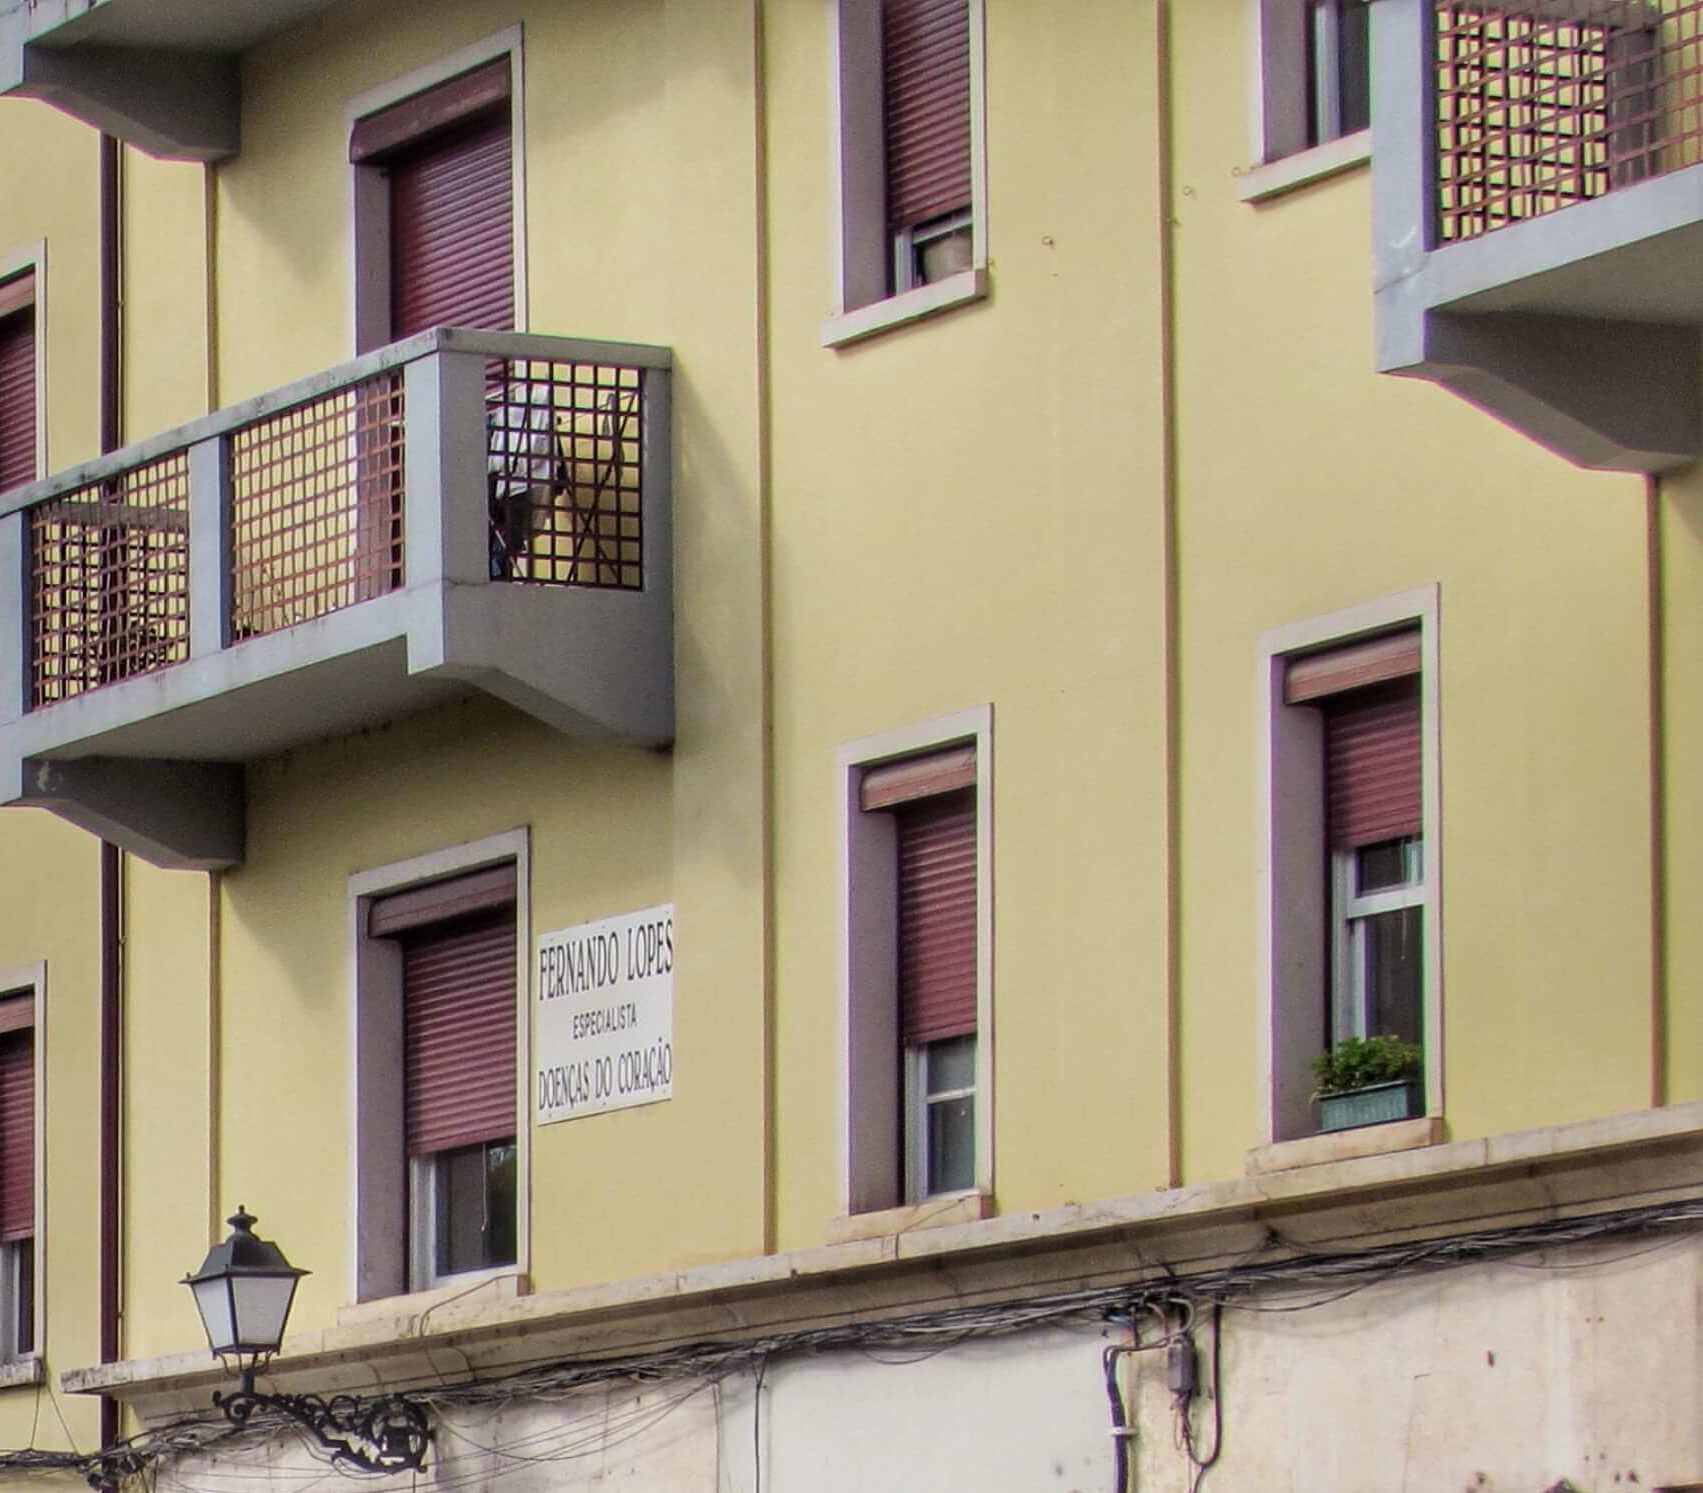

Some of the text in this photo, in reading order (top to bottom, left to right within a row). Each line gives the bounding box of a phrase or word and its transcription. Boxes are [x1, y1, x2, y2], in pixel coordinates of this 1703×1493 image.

[539, 919, 673, 1000] FERNANDO LOPES
[573, 1003, 637, 1040] ESPECIALISTA
[539, 1037, 672, 1110] DOENÇAS DO CORAÇÃO
